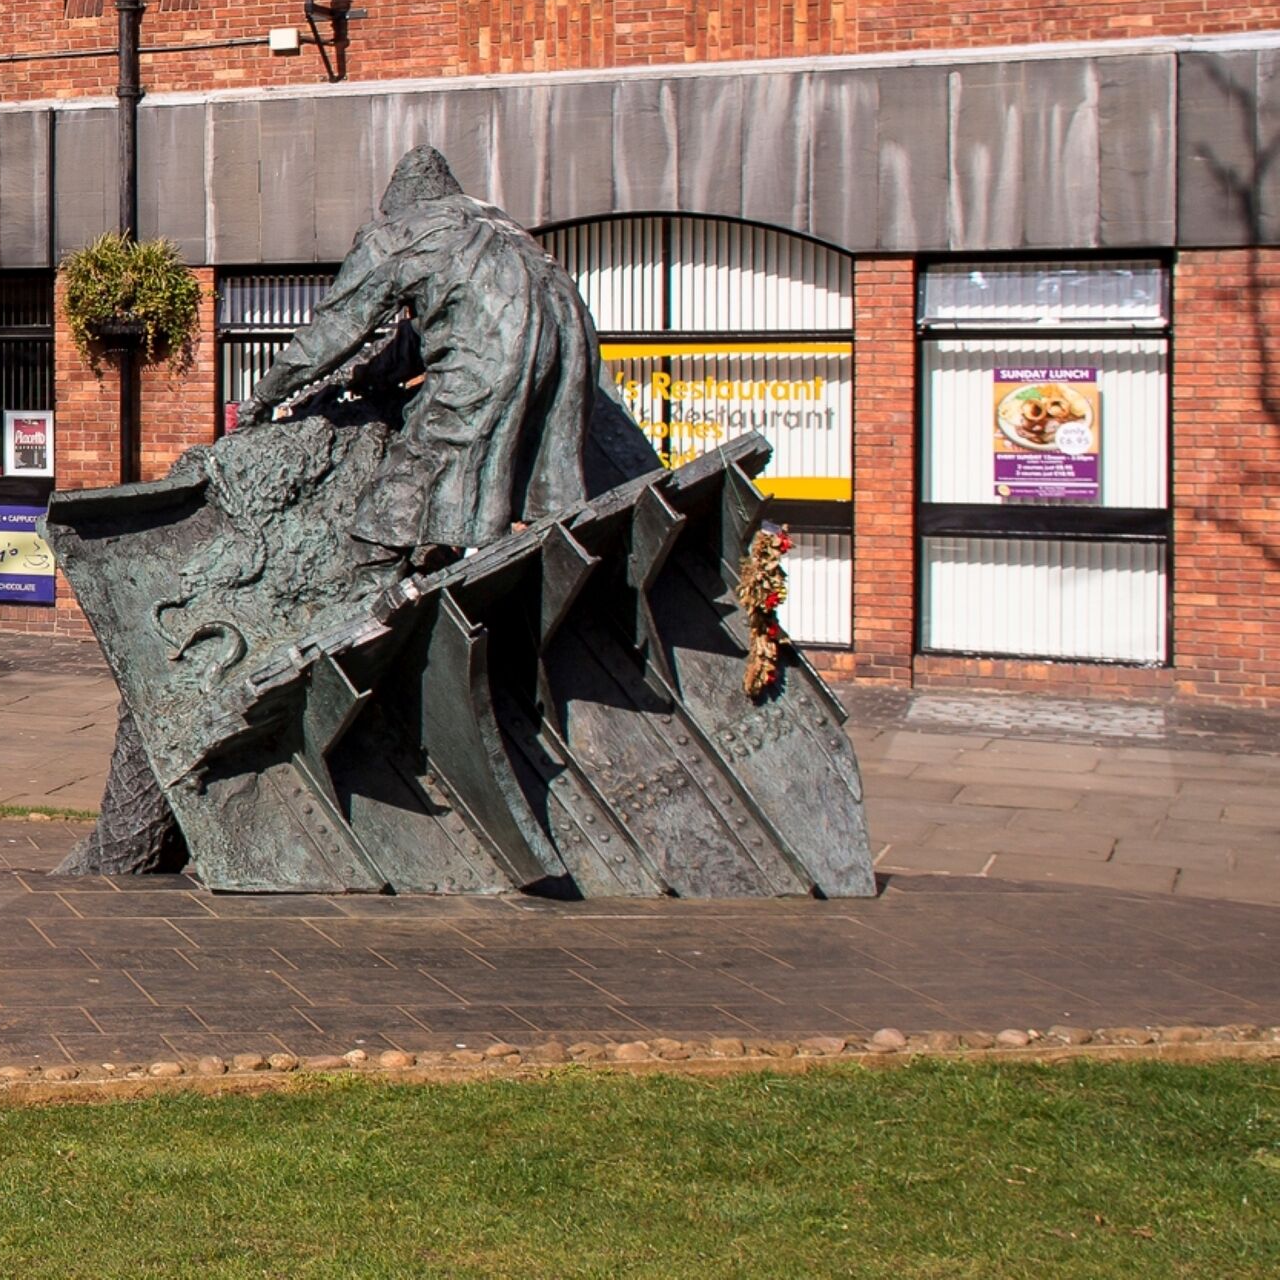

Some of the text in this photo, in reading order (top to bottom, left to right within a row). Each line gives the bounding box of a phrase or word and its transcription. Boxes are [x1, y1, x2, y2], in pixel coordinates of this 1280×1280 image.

[1000, 370, 1090, 379] SUNDAY LUNCH
[651, 371, 824, 401] Restaurant
